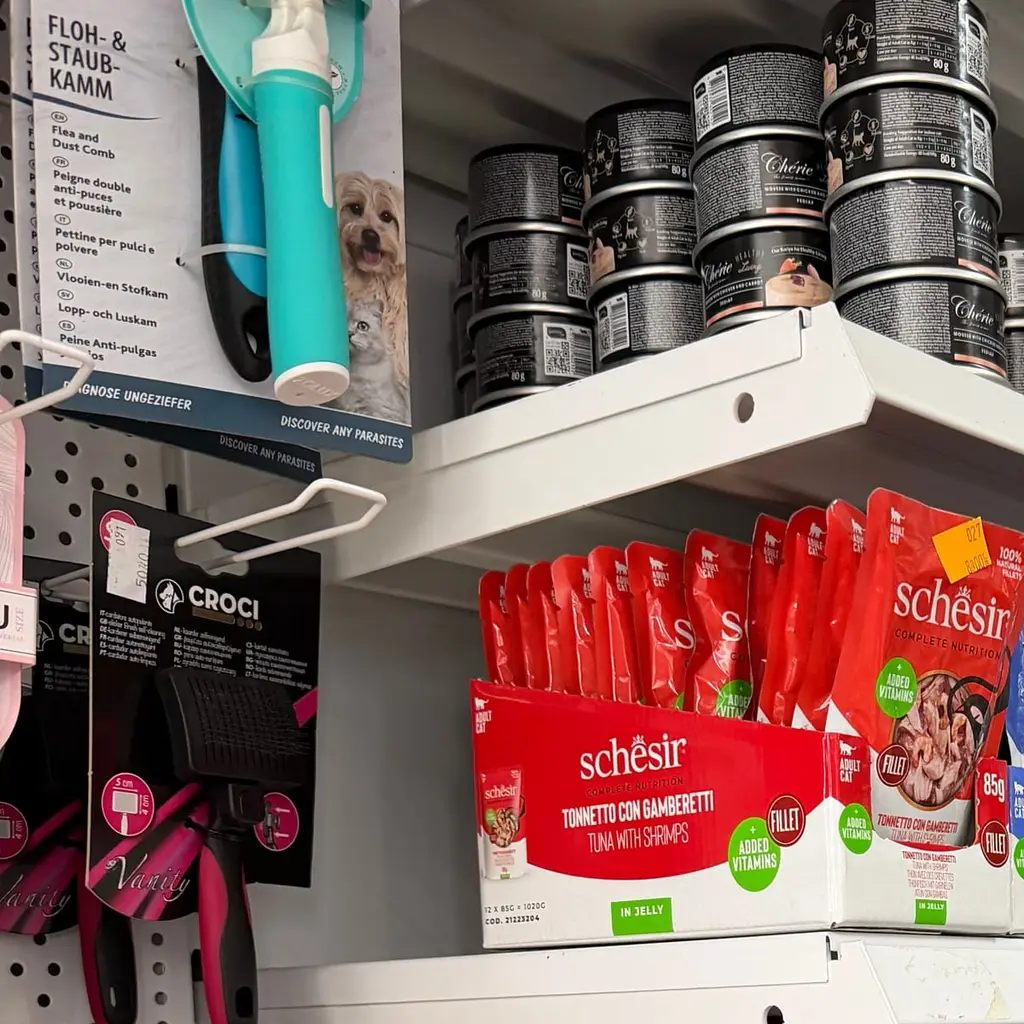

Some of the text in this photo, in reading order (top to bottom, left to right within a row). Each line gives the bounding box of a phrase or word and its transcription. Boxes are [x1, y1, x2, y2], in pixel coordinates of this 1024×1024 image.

[49, 14, 127, 53] FLOH- &
[49, 42, 121, 74] STAUB-
[933, 59, 943, 69] 80
[49, 69, 113, 101] KAMM
[52, 125, 99, 144] Flea and
[52, 138, 115, 159] Dust Comb
[940, 153, 950, 164] 80
[761, 152, 814, 176] Chérie
[53, 170, 132, 194] Peigne double
[53, 185, 114, 203] anti-puces
[54, 197, 123, 218] et poussière
[954, 200, 992, 233] Chérie
[55, 227, 155, 255] Pettine per pulci e
[55, 241, 99, 258] polvere
[57, 272, 168, 300] Vlooien-en Stofkam
[58, 303, 157, 327] Lopp- och Luskam
[951, 295, 994, 325] Chérie
[60, 333, 157, 359] Peine Anti-pulgas
[63, 380, 192, 411] DAGNOSE UNGEZIEFER
[280, 414, 404, 450] DISCOVER ANY PARASITES
[219, 434, 316, 473] DISCOVER ANY PARASITES
[966, 523, 982, 543] 027
[999, 547, 1022, 565] 100%
[188, 585, 259, 619] CROCI
[895, 629, 1001, 660] COMPLETE NUTRITION
[886, 673, 910, 688] ADDED
[879, 683, 914, 703] VITAMINS
[475, 708, 492, 726] ADULT
[475, 722, 487, 735] CAT
[839, 757, 861, 774] ADULT
[882, 755, 907, 777] FILLET
[115, 778, 134, 789] 5 cm
[839, 771, 853, 783] CAT
[983, 772, 1005, 803] 85g
[562, 790, 714, 829] TONNETTO CON GAMBERETTI
[771, 807, 800, 834] FILLET
[1014, 808, 1024, 820] CAT
[846, 817, 866, 829] ADDED
[877, 813, 911, 830] TONNETTO
[912, 818, 926, 831] CON
[587, 822, 689, 855] TUNA WITH SHRIMPS
[739, 834, 770, 855] ADDED
[842, 826, 871, 841] VITAMINS
[985, 833, 1006, 856] FILLET
[732, 849, 778, 871] VITAMINS
[105, 853, 191, 902] Vanity
[484, 904, 492, 914] 12
[620, 904, 664, 918] IN JELLY
